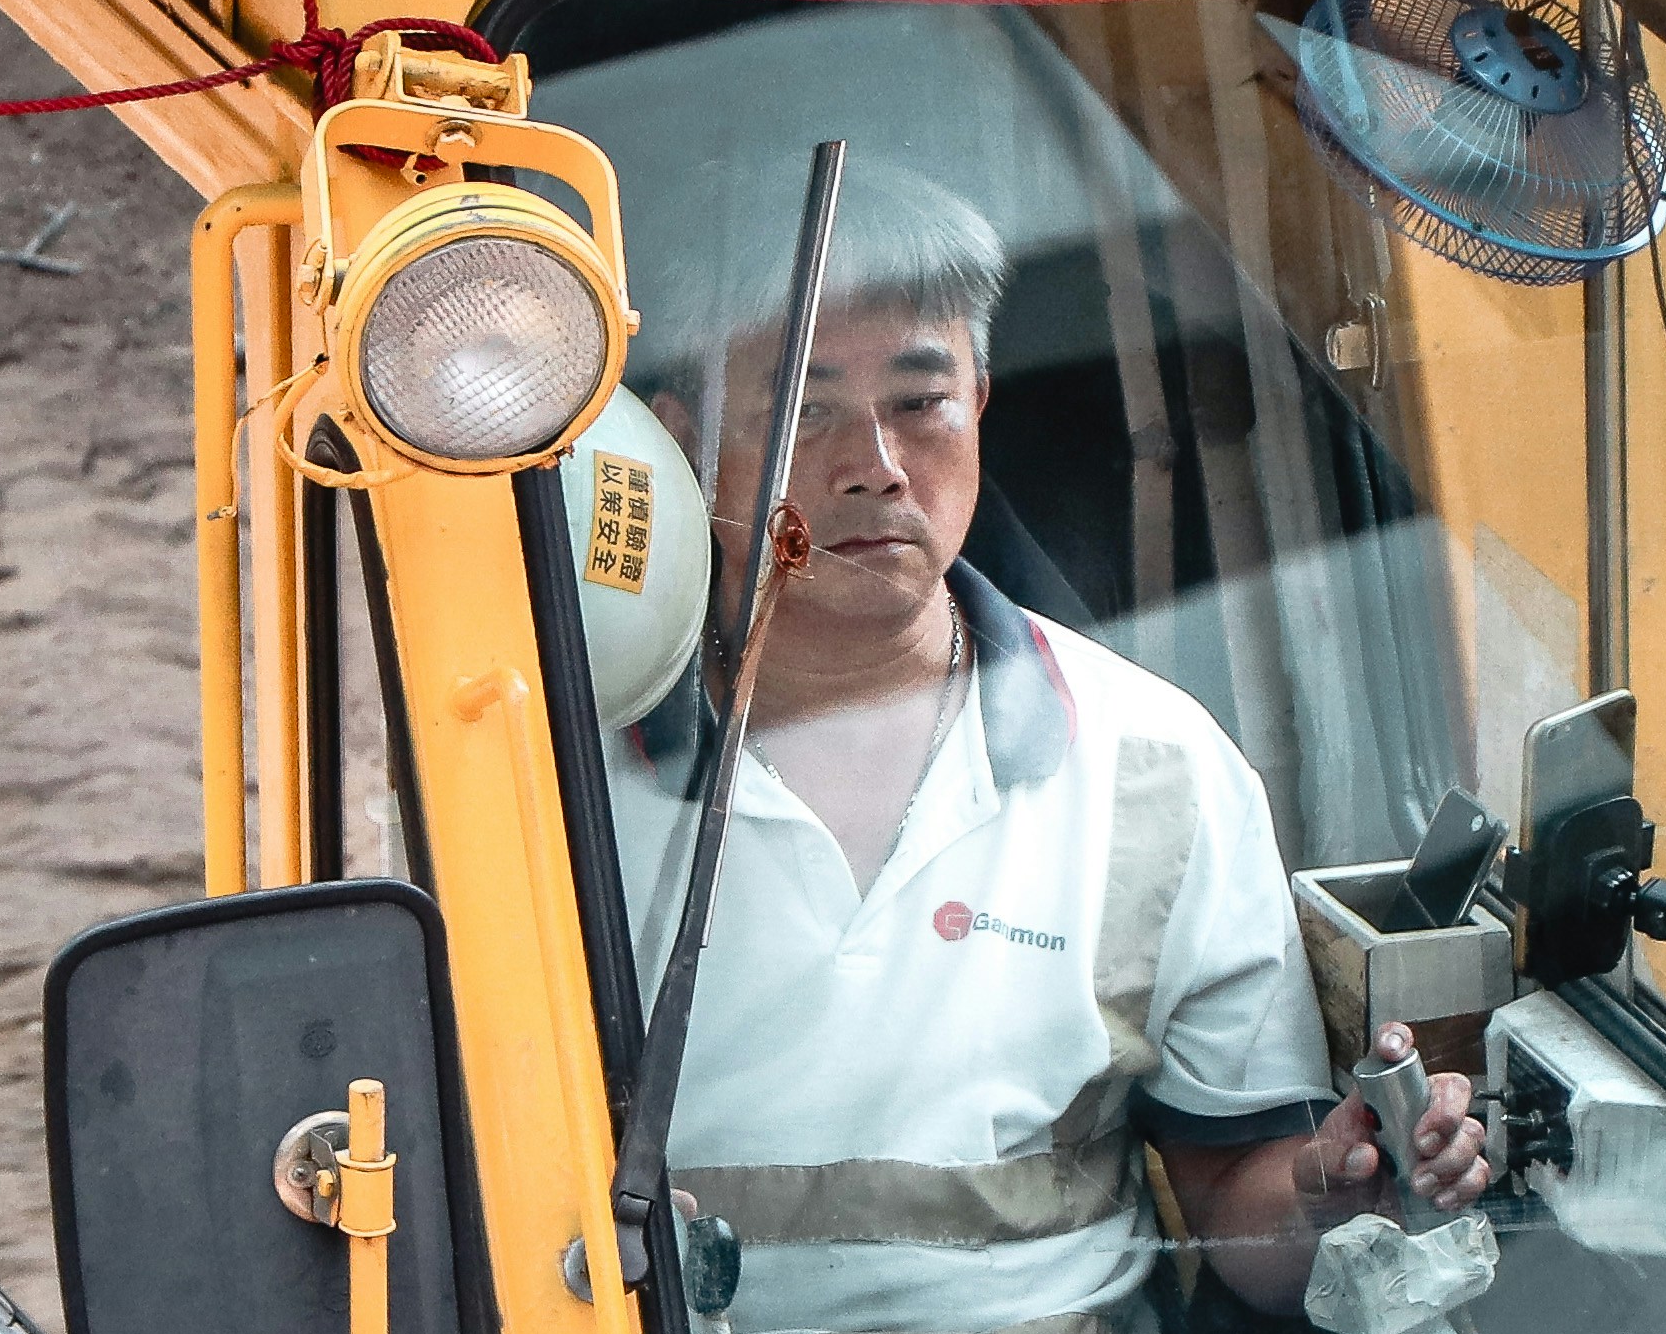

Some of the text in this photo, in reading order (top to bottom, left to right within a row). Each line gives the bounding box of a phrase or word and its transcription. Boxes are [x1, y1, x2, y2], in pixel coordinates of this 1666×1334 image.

[590, 460, 624, 576] 以策安全
[618, 464, 650, 585] 謹慎驗證
